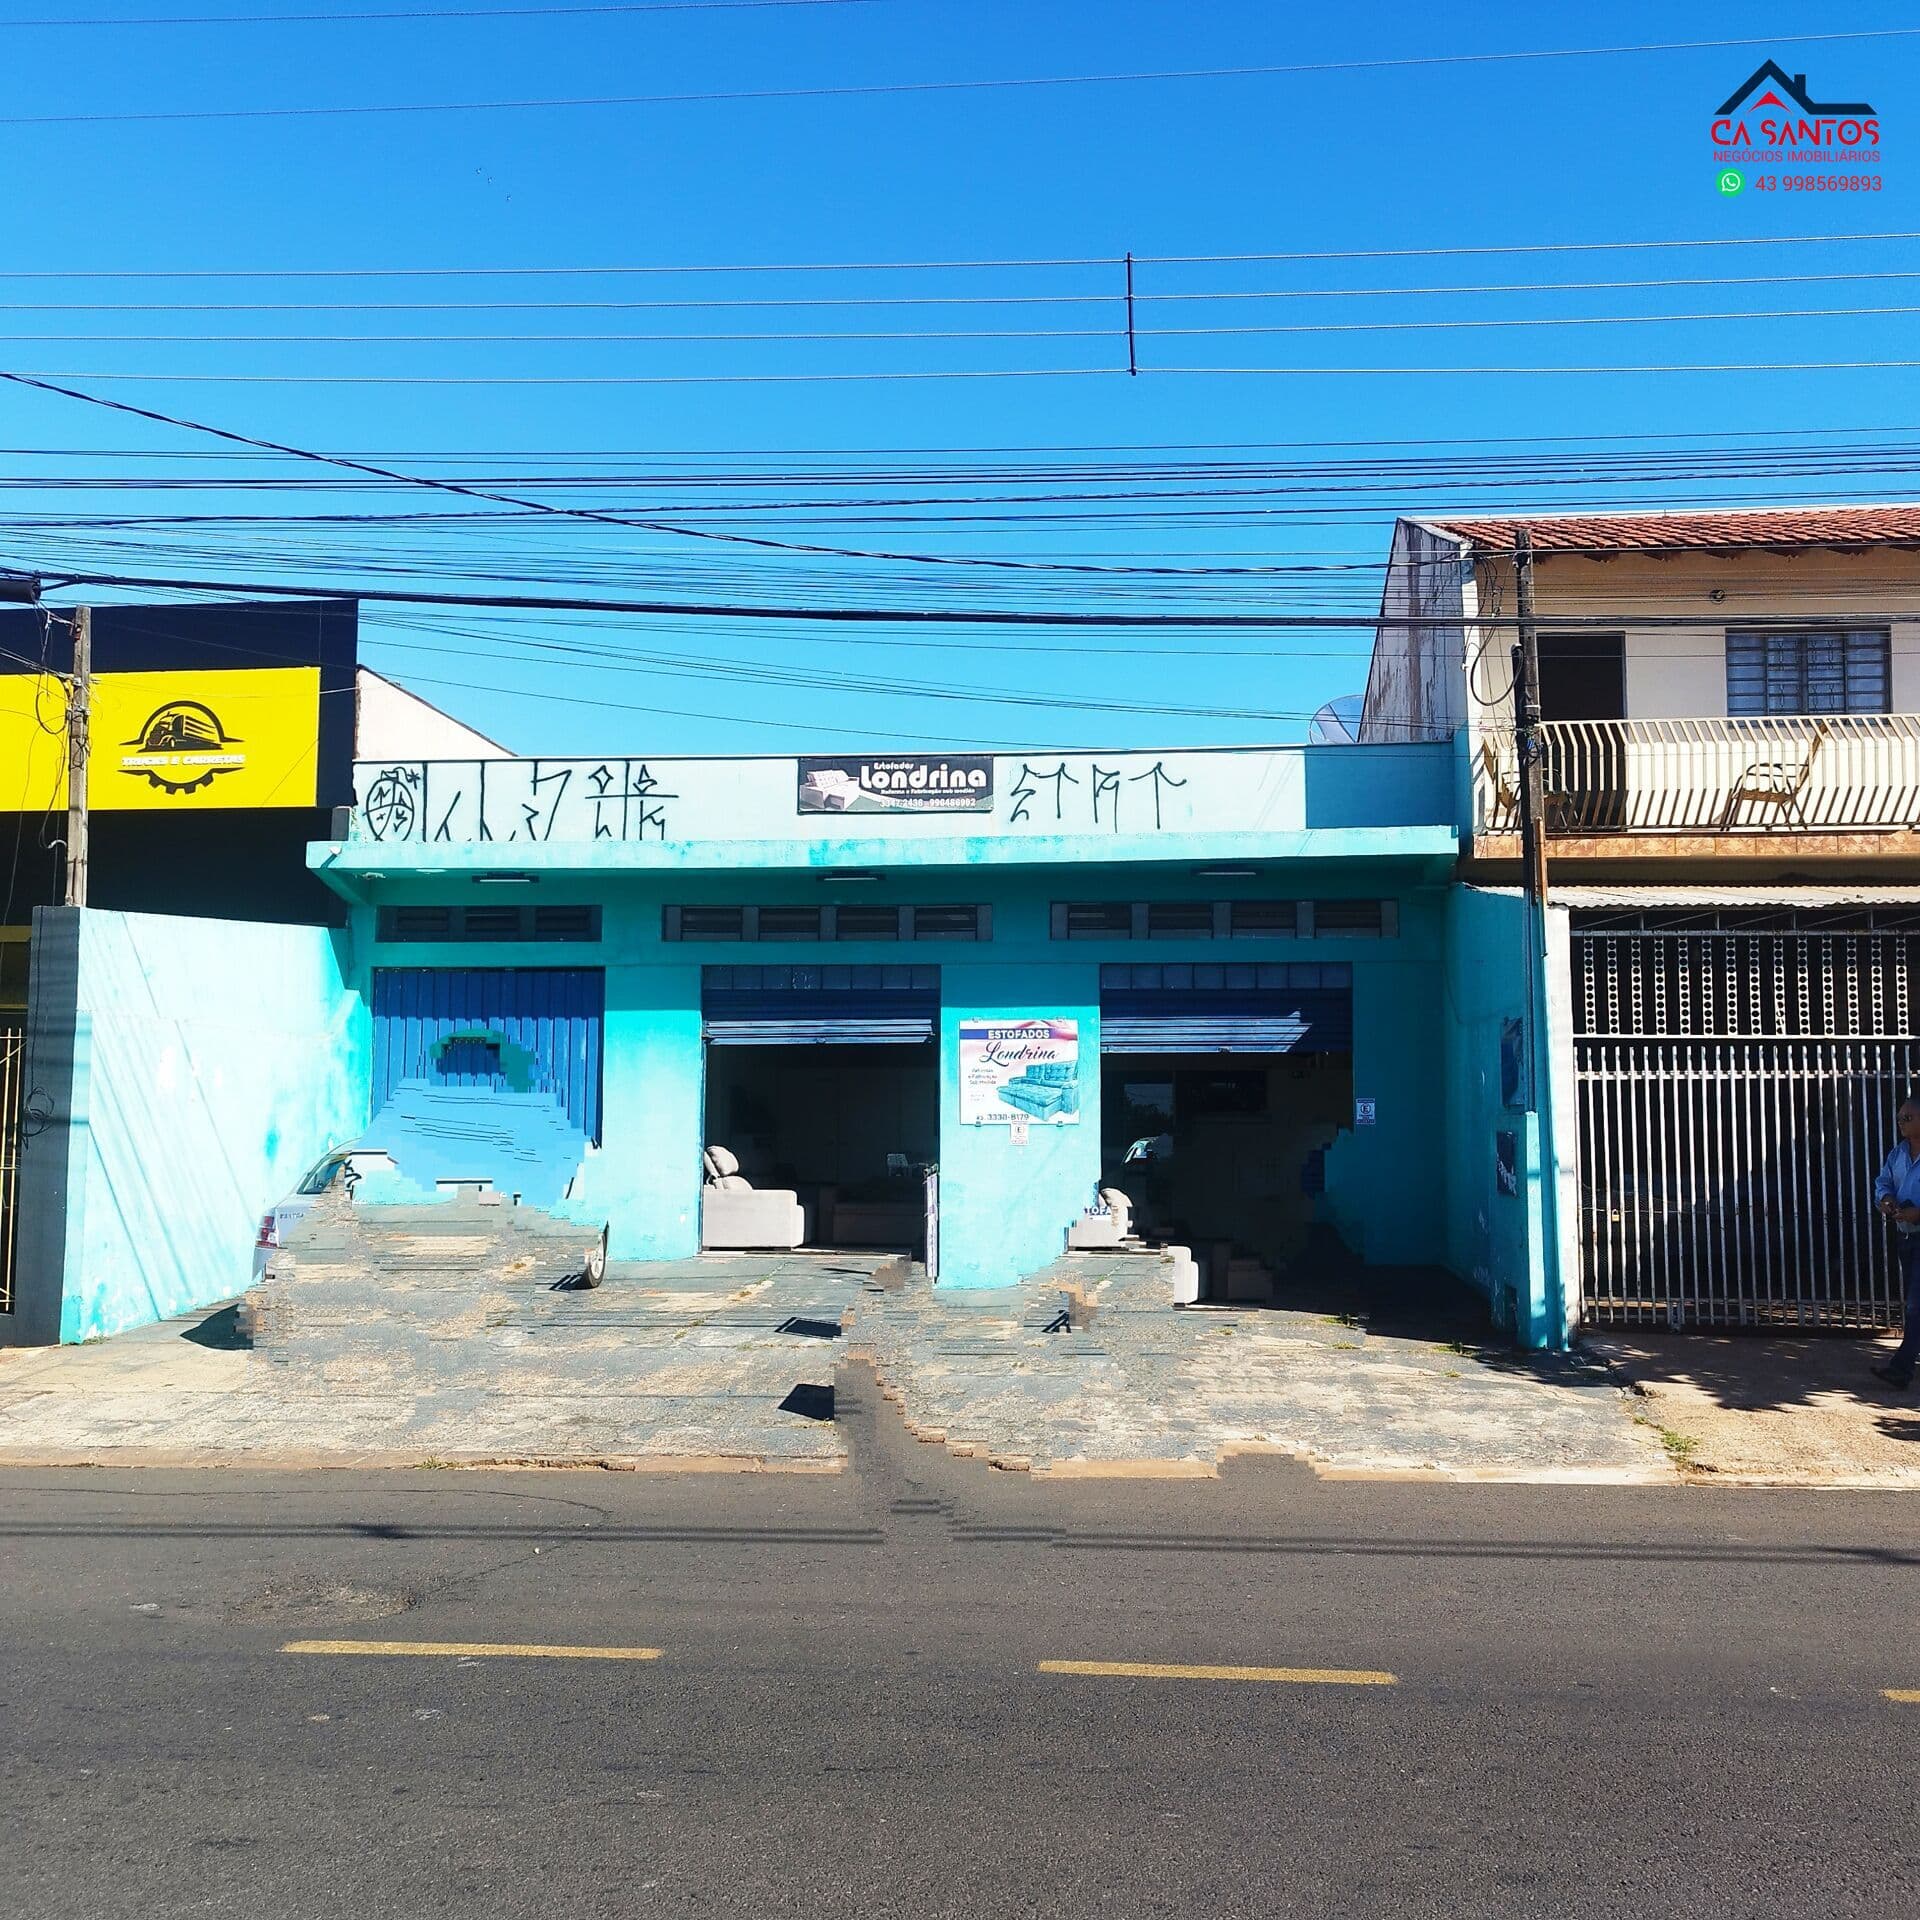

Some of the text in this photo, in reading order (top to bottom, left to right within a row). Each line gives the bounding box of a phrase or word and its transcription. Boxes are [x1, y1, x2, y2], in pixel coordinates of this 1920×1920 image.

[873, 761, 914, 771] Estofados
[860, 763, 987, 789] Londrina
[987, 1029, 1050, 1039] ESTOFADOS
[979, 1041, 1057, 1067] Londrina
